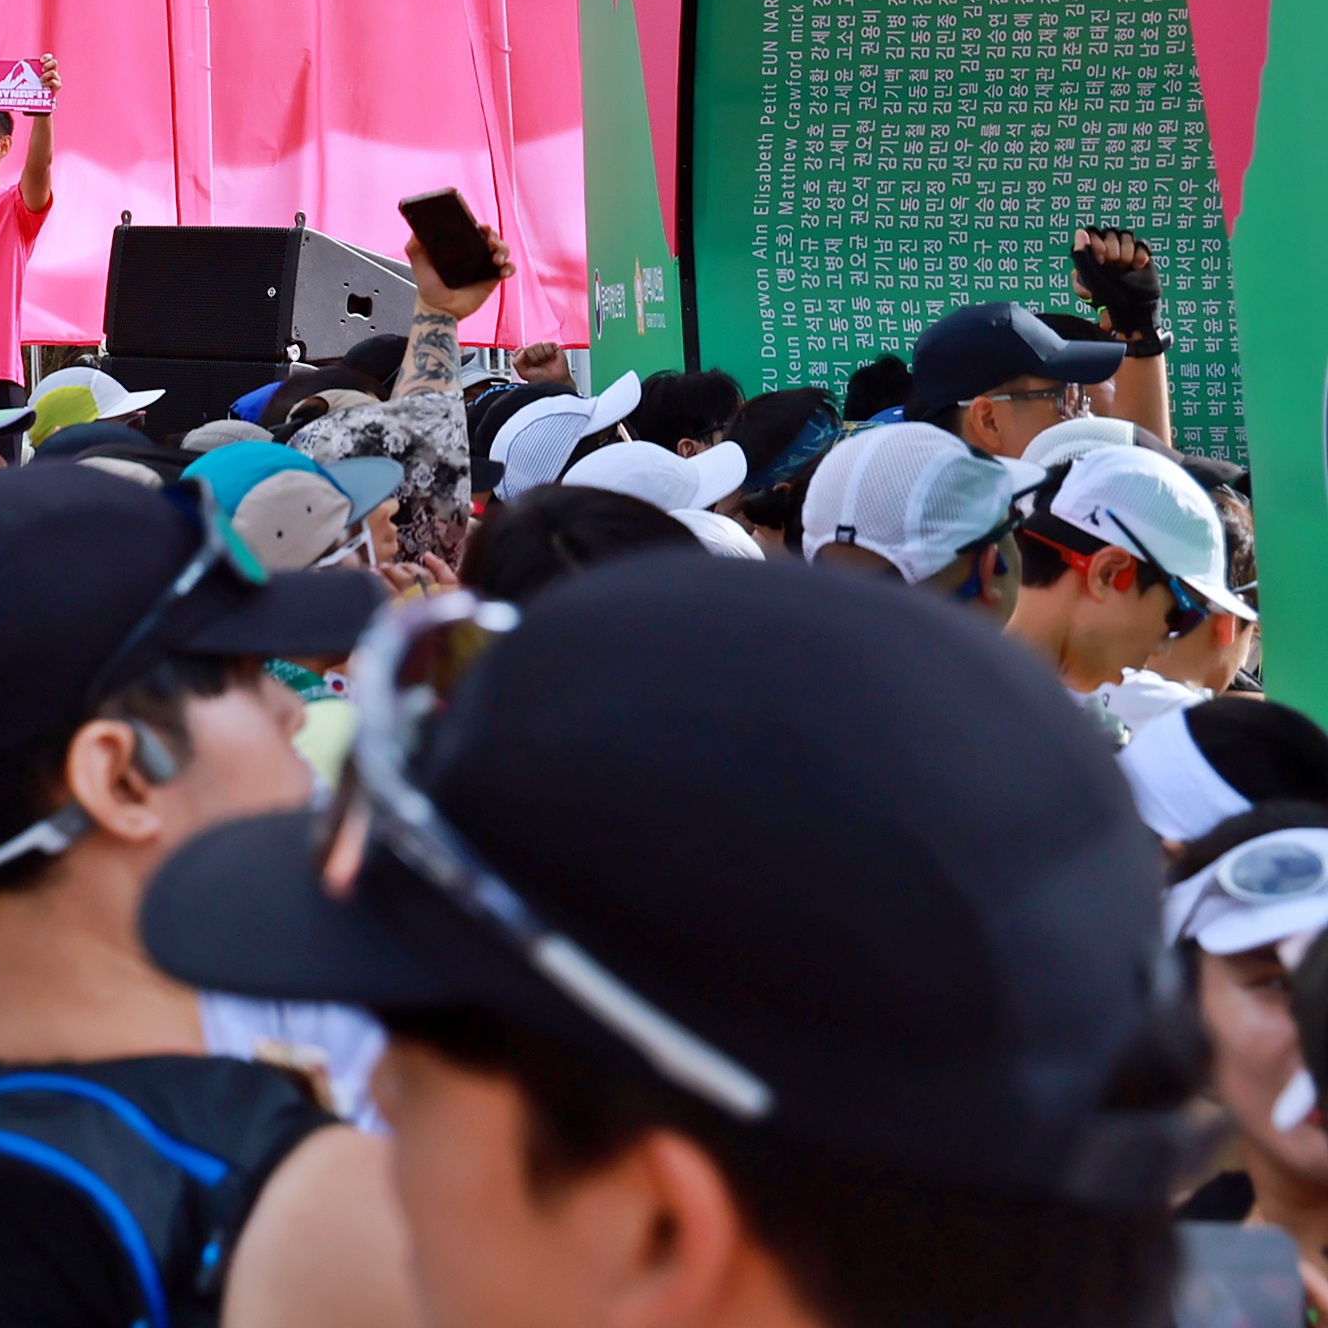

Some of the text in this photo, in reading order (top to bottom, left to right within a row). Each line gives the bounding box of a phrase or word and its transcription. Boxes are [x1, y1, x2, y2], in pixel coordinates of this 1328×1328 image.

[787, 4, 804, 42] mick
[810, 15, 831, 60] 강세원
[836, 15, 856, 61] 고소연
[761, 41, 778, 75] EUN
[759, 83, 777, 125] Petit
[783, 50, 803, 130] Crawford
[808, 67, 829, 115] 강성환
[833, 68, 853, 115] 고세윤
[803, 123, 824, 171] 강성호
[829, 124, 851, 171] 고세미
[1151, 119, 1179, 227] 민관기 민세원
[753, 133, 774, 215] Elisabeth
[777, 137, 798, 215] Matthew
[1074, 120, 1102, 227] 김태원 김태윤
[1099, 122, 1127, 229] 김형운 김형일
[1125, 121, 1153, 229] 남현정 남현종
[800, 179, 821, 228] 강성호
[825, 179, 846, 229] 고성관
[1024, 180, 1046, 229] 김자영
[751, 224, 768, 259] Ahn
[898, 180, 921, 289] 김동진 김동진
[923, 180, 946, 290] 김민정 김민정
[947, 195, 970, 307] 김선영 김선옥
[997, 180, 1021, 290] 김용경 김용민
[1048, 195, 1071, 307] 김준식 김준영
[799, 237, 820, 289] 강선규
[823, 238, 844, 289] 고병재
[973, 238, 994, 290] 김승구
[756, 268, 776, 358] Dongwon
[781, 301, 797, 326] Ho
[849, 234, 874, 349] 권영동 권오균
[873, 237, 899, 351] 김규화 김기남
[801, 298, 826, 351] 강석민
[826, 299, 849, 352] 고동석
[762, 368, 778, 393] ZU
[786, 336, 801, 384] Keun
[1201, 298, 1227, 416] 박원중 박윤하
